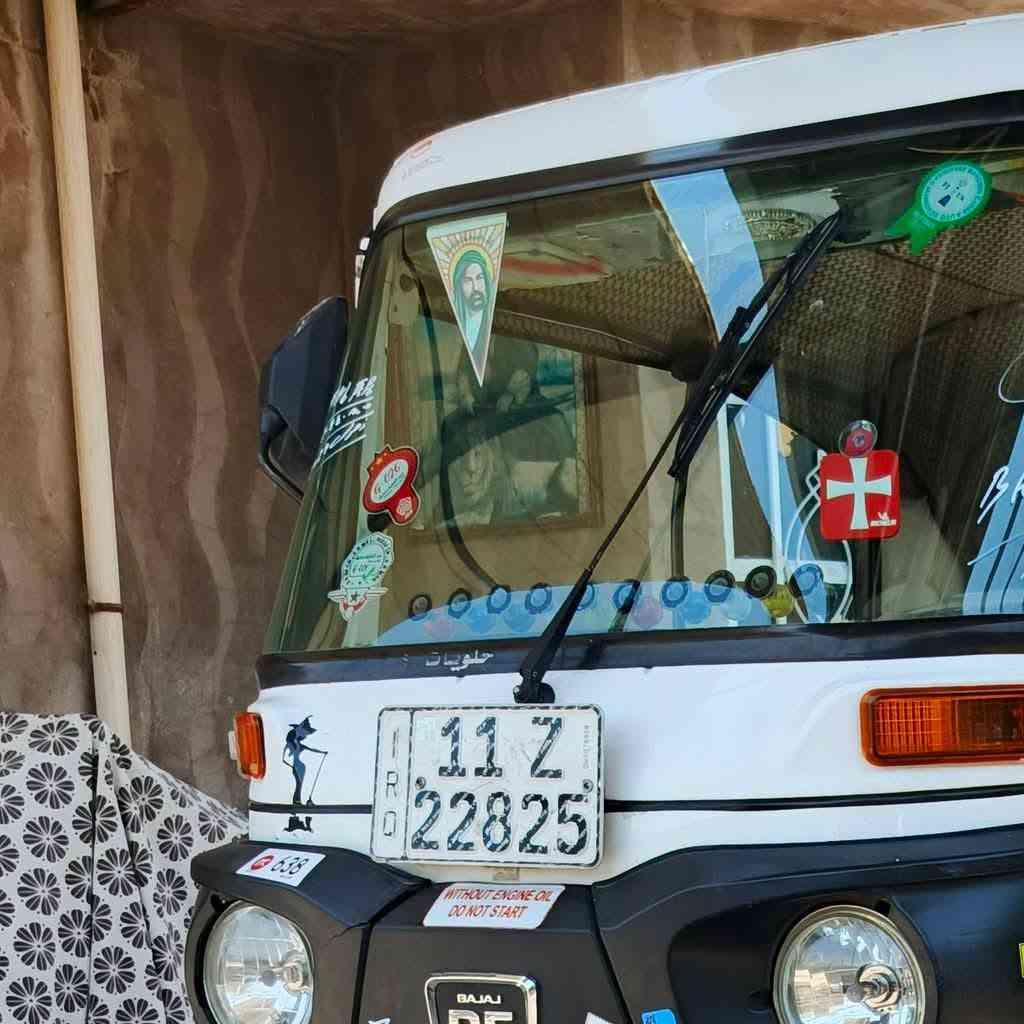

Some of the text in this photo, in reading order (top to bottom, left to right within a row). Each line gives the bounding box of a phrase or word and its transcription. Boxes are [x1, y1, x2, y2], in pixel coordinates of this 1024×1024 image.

[438, 716, 503, 777] 11
[530, 716, 563, 779] Z
[411, 790, 588, 856] 22825
[271, 855, 309, 875] 638
[444, 887, 553, 902] WITHOUT ENGINE OIL
[448, 904, 528, 919] DO NOT START
[456, 993, 501, 1004] BAJAJ
